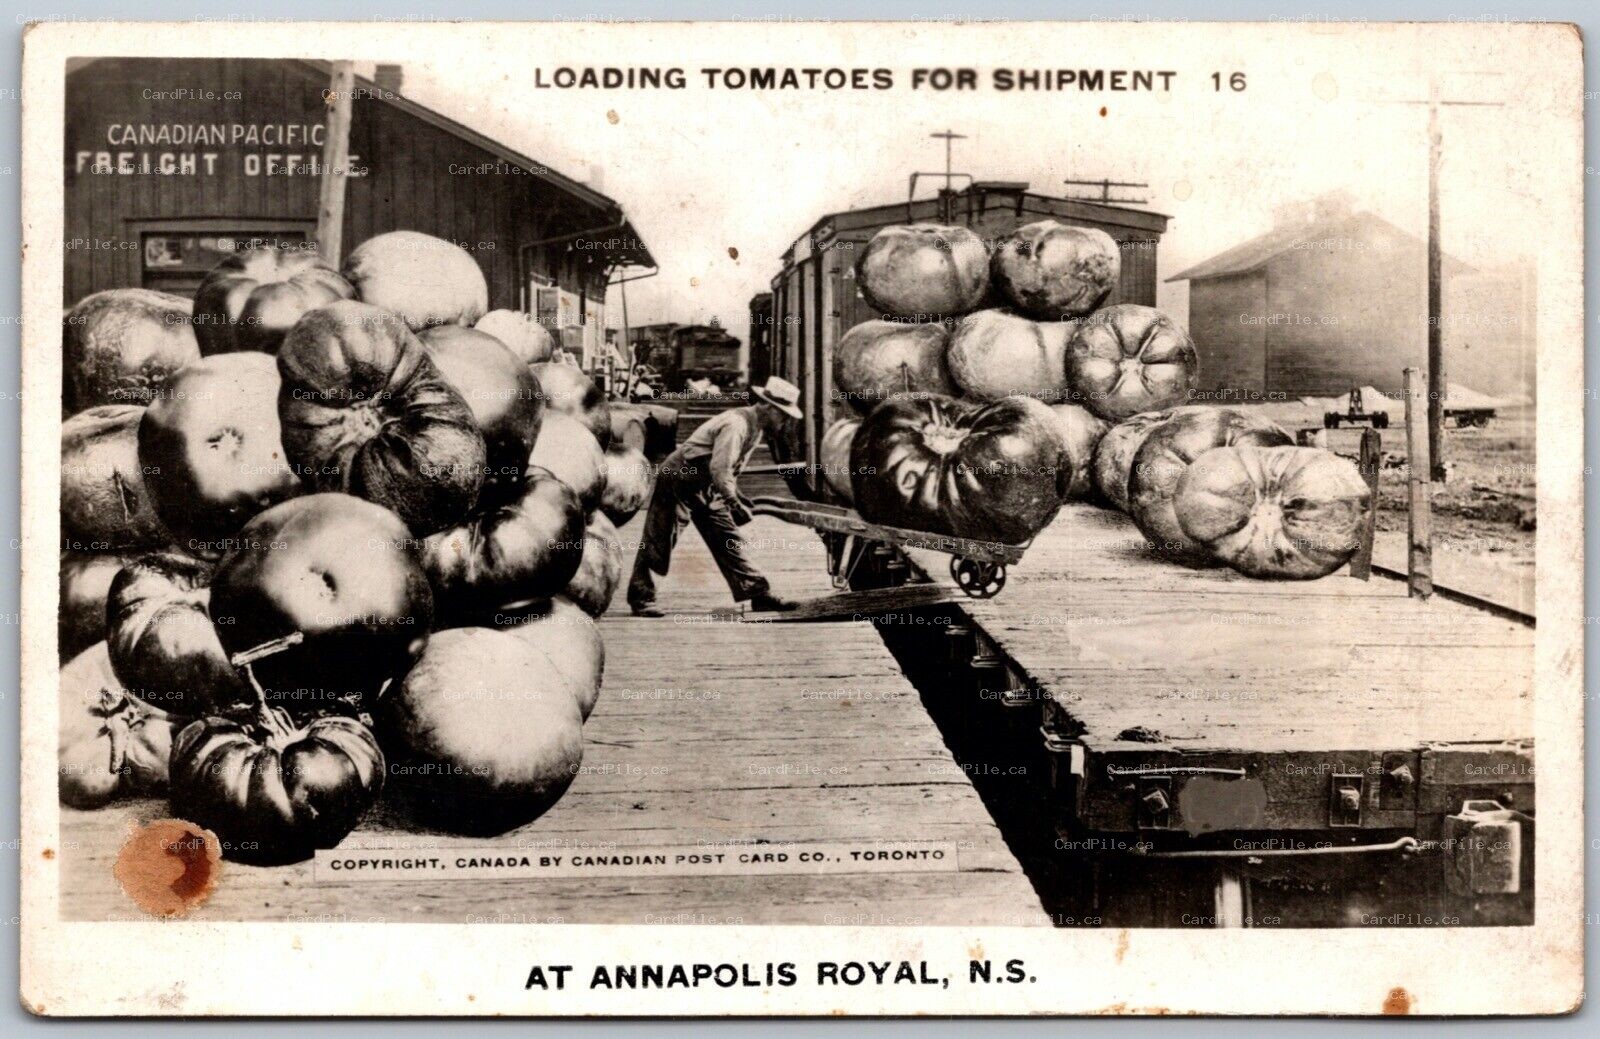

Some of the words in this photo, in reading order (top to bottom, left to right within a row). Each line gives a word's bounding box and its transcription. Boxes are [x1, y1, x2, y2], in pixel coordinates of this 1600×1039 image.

[107, 123, 226, 146] CANADIAN
[231, 123, 326, 146] PACIFIC
[75, 151, 218, 176] FREIGHT
[243, 153, 361, 178] OFFIE
